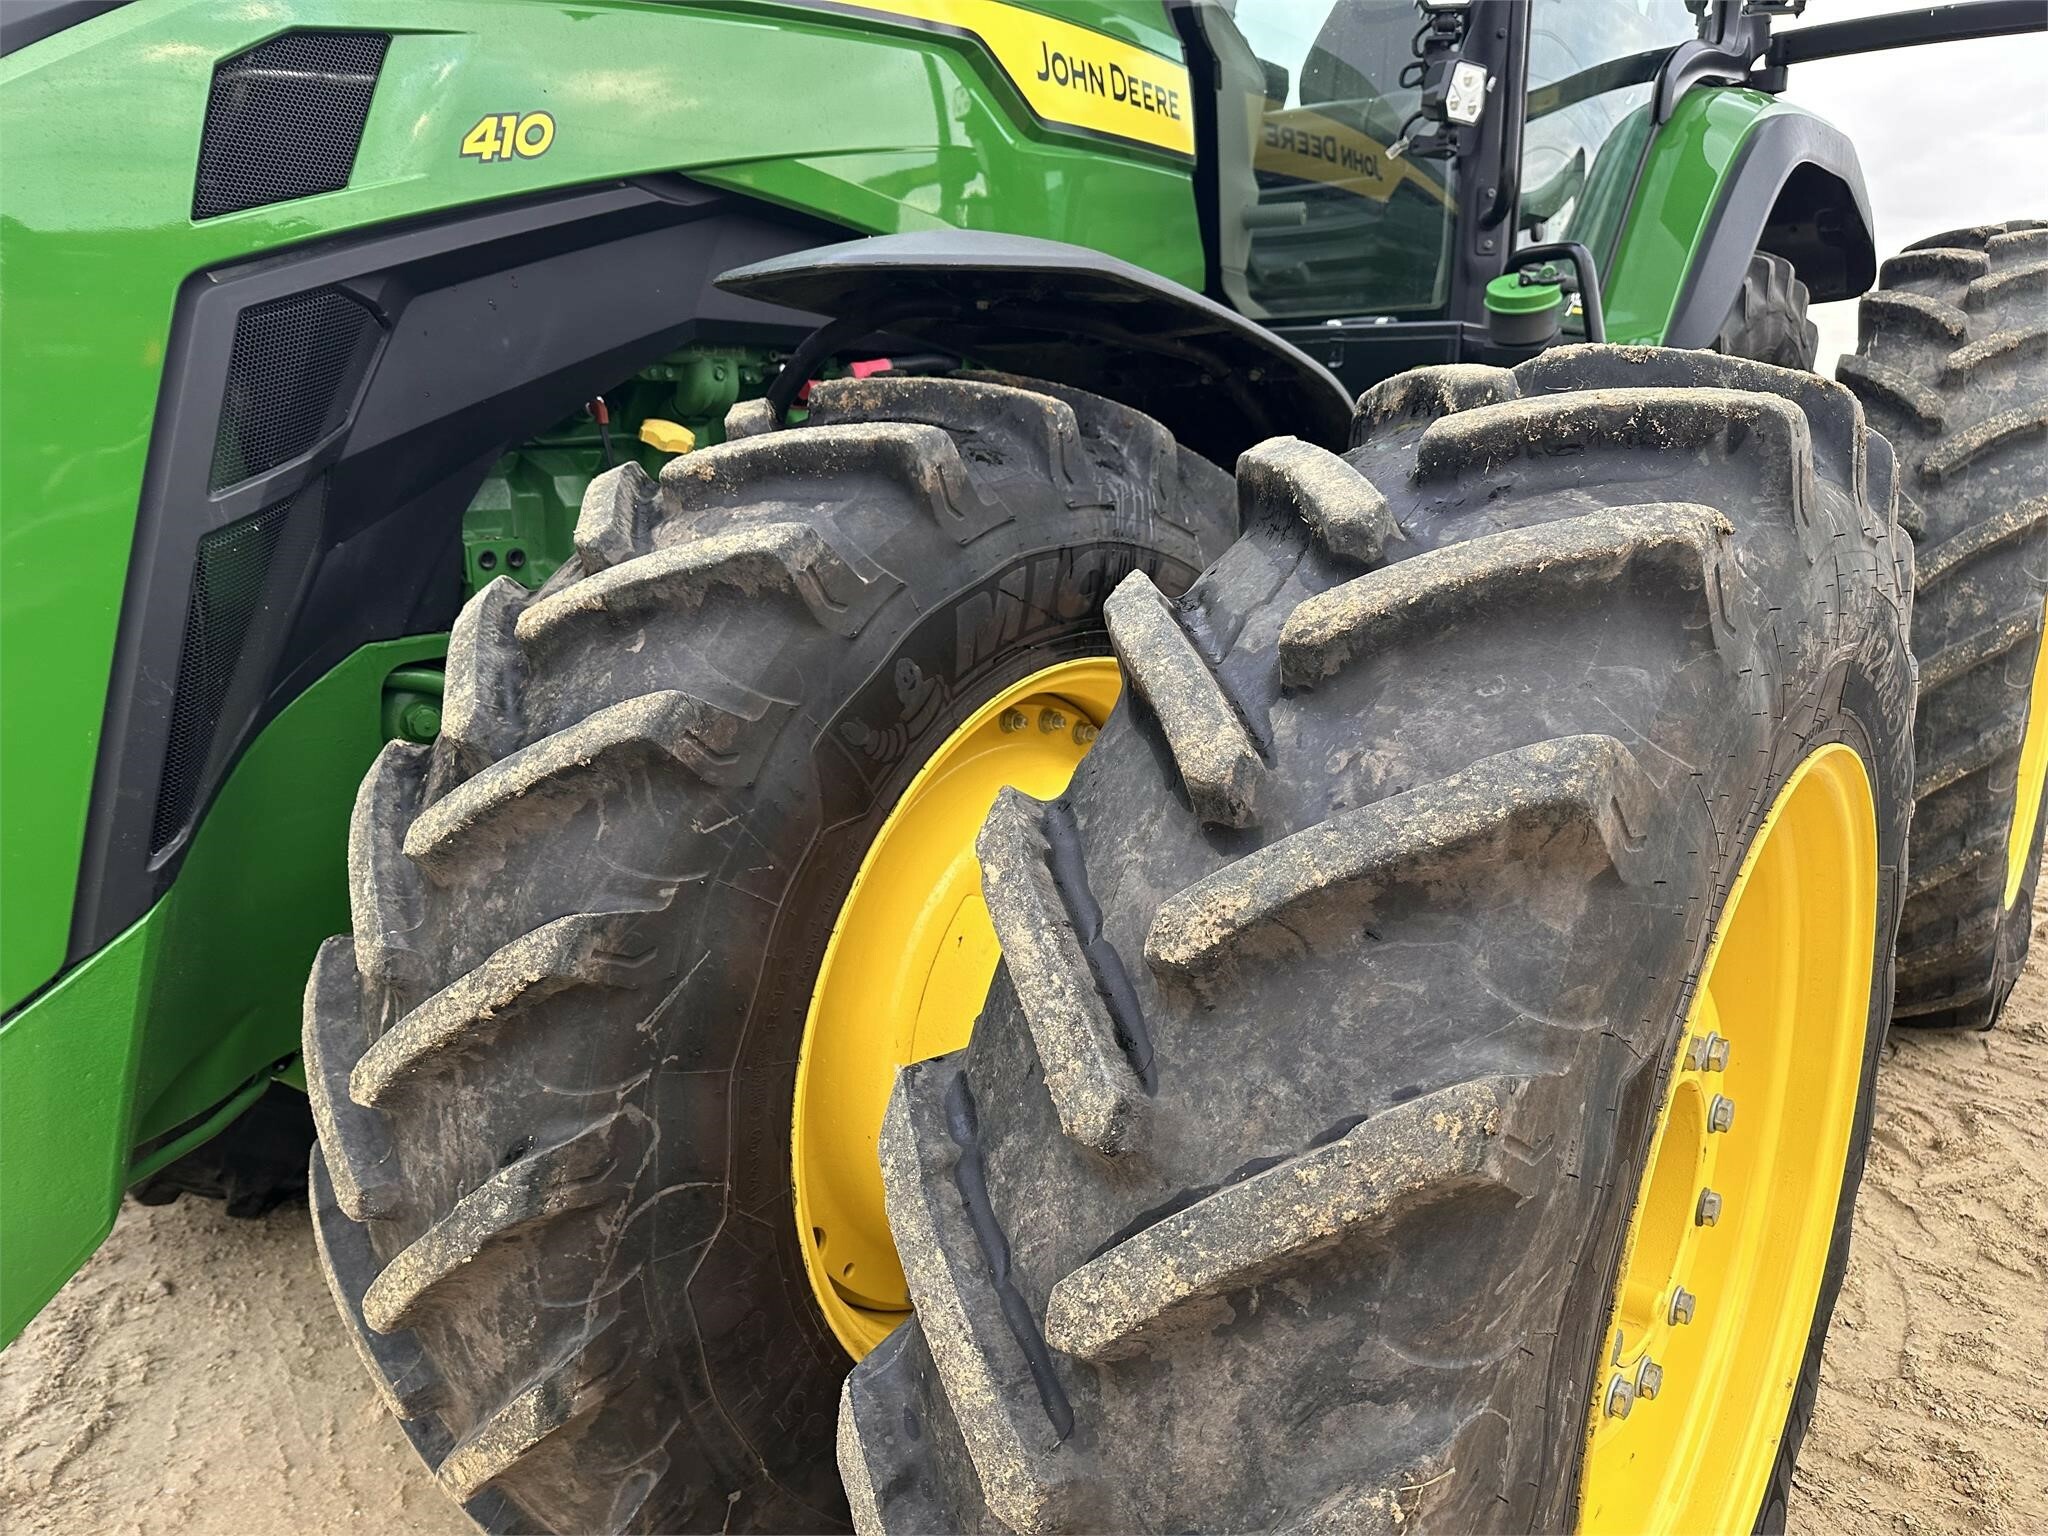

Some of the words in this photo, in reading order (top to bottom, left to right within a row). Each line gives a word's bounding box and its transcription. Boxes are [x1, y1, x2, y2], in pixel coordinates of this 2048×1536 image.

[1037, 41, 1106, 98] JOHN
[1109, 62, 1182, 121] DEERE
[460, 111, 555, 163] 410
